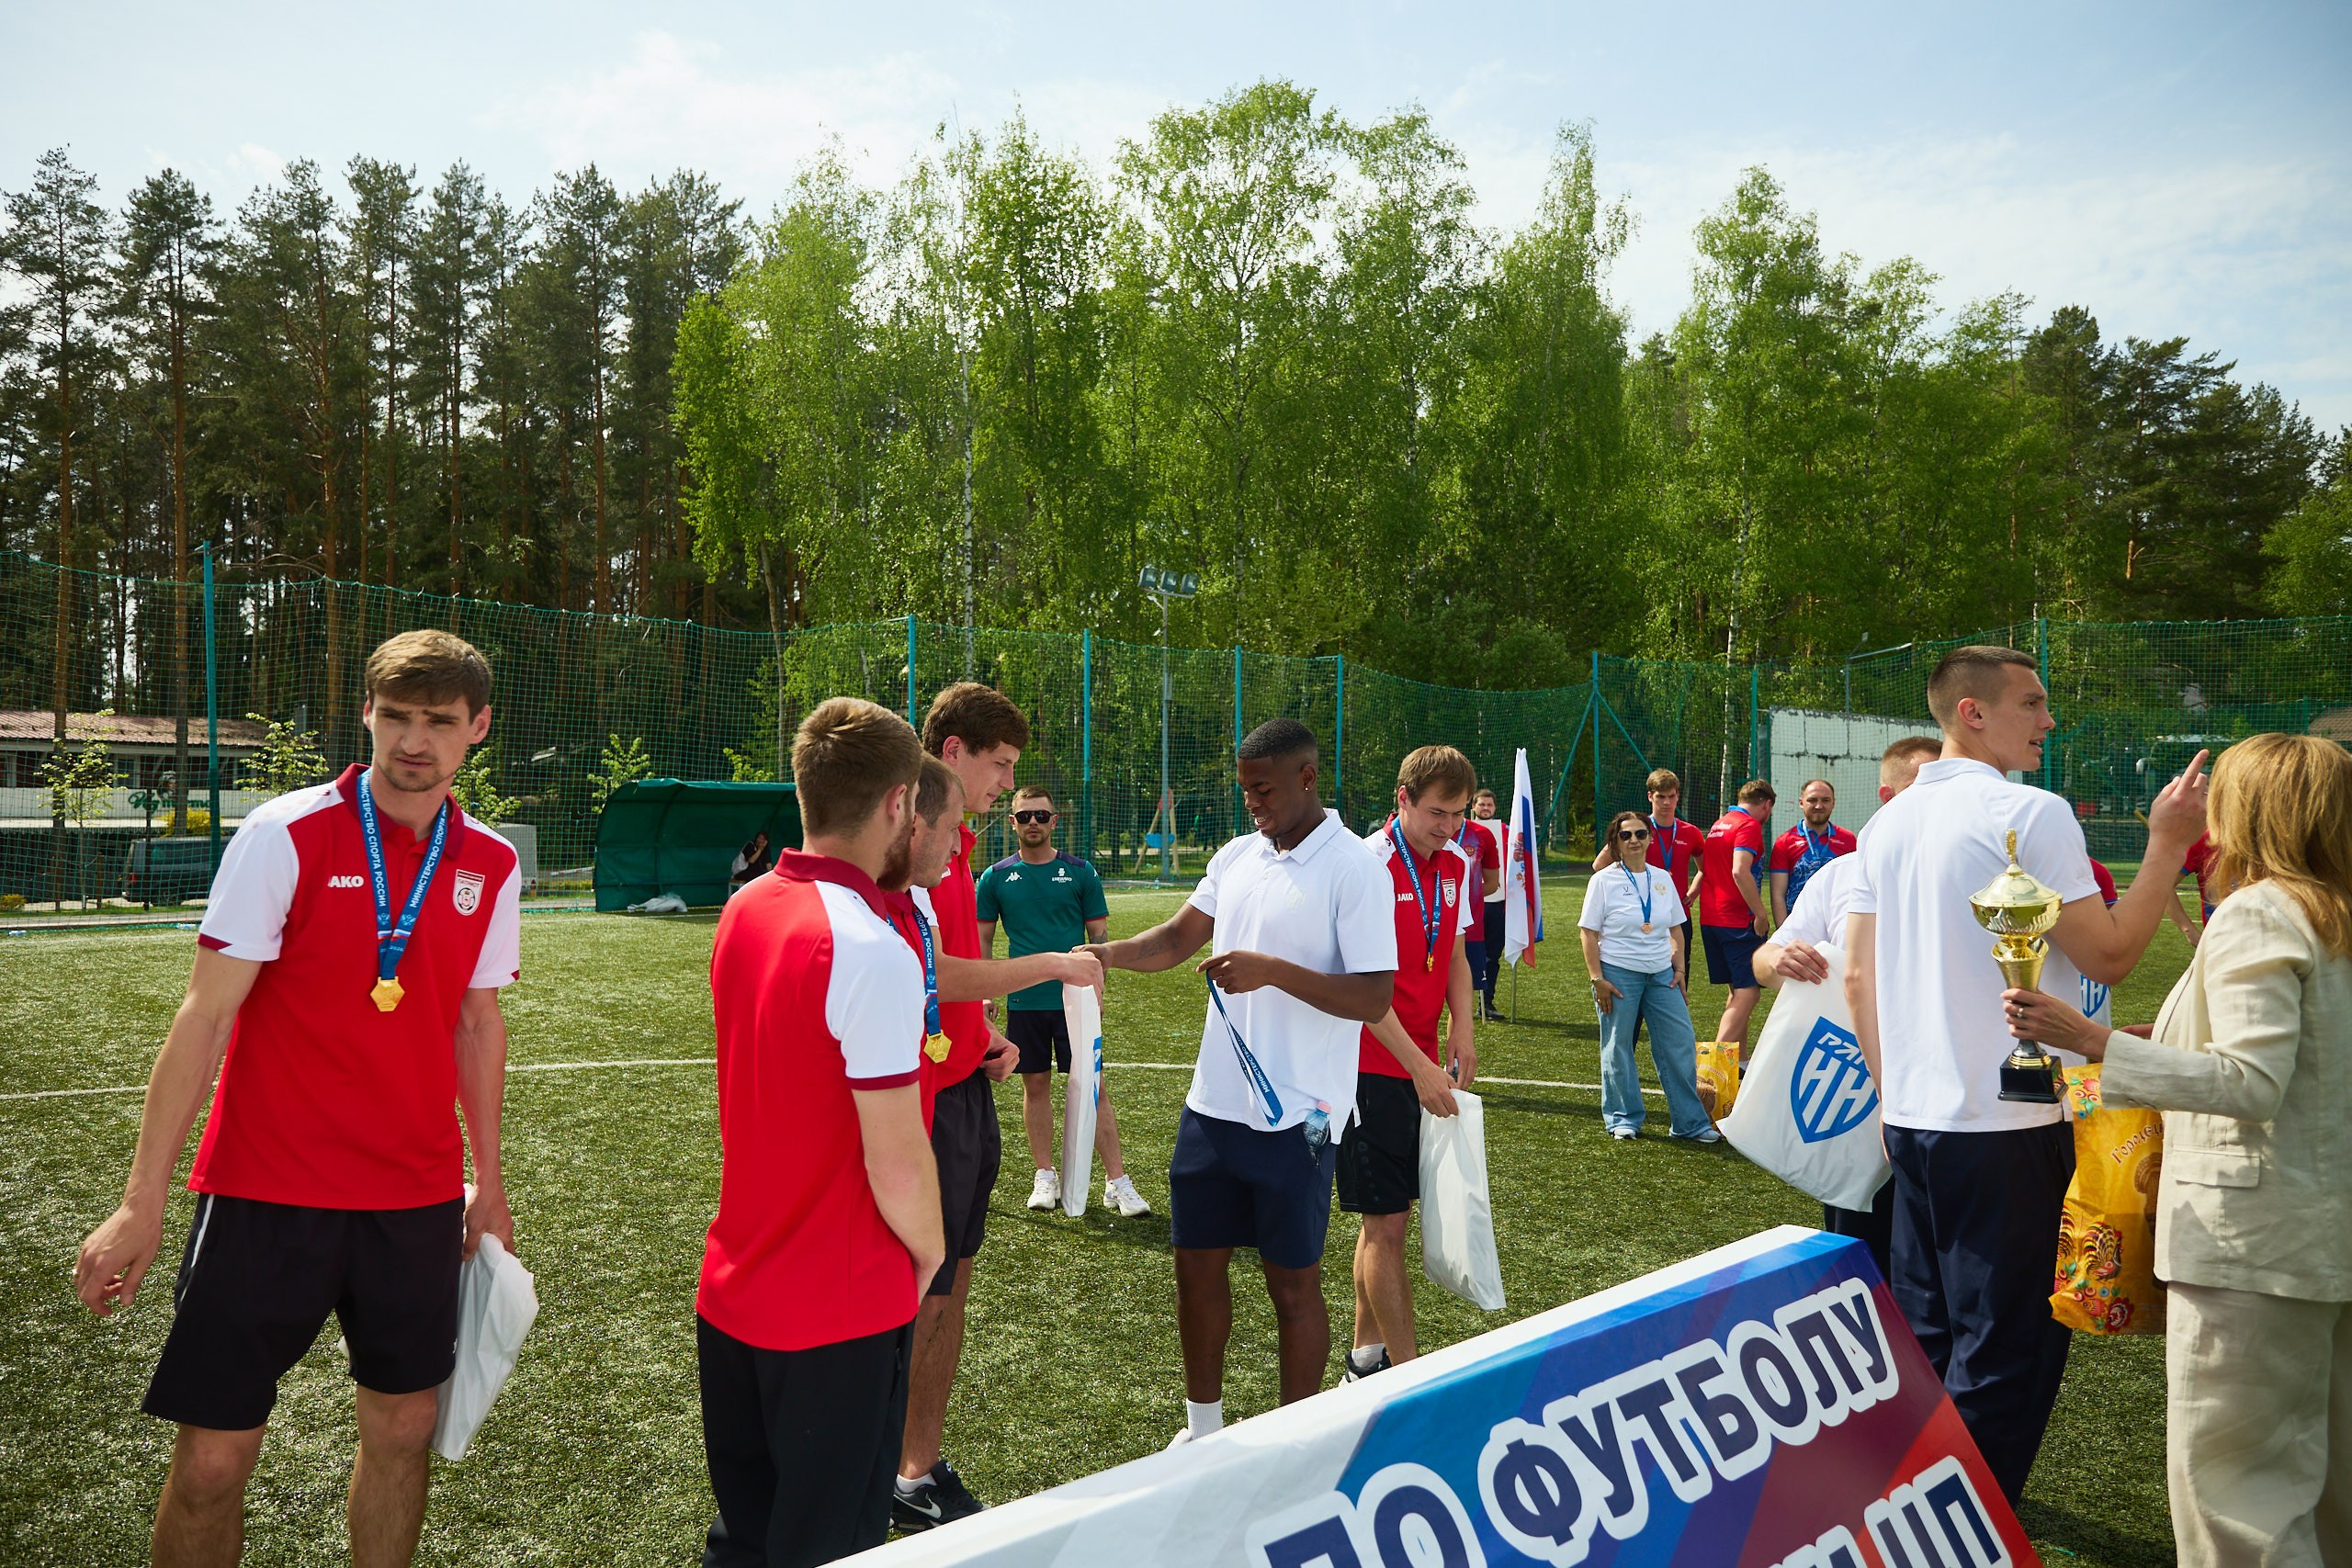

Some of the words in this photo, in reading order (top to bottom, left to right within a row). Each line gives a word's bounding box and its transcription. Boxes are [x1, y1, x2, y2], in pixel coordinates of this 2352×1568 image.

[368, 836, 381, 869] СПОРТА
[375, 871, 387, 907] РОССИИ
[410, 845, 440, 908] МИНИСТЕРСТВО
[435, 818, 447, 845] СПОРТА
[1397, 893, 1414, 902] JAKO
[924, 937, 933, 969] РОССИИ
[1493, 1292, 1888, 1547] ФУТБОЛУ
